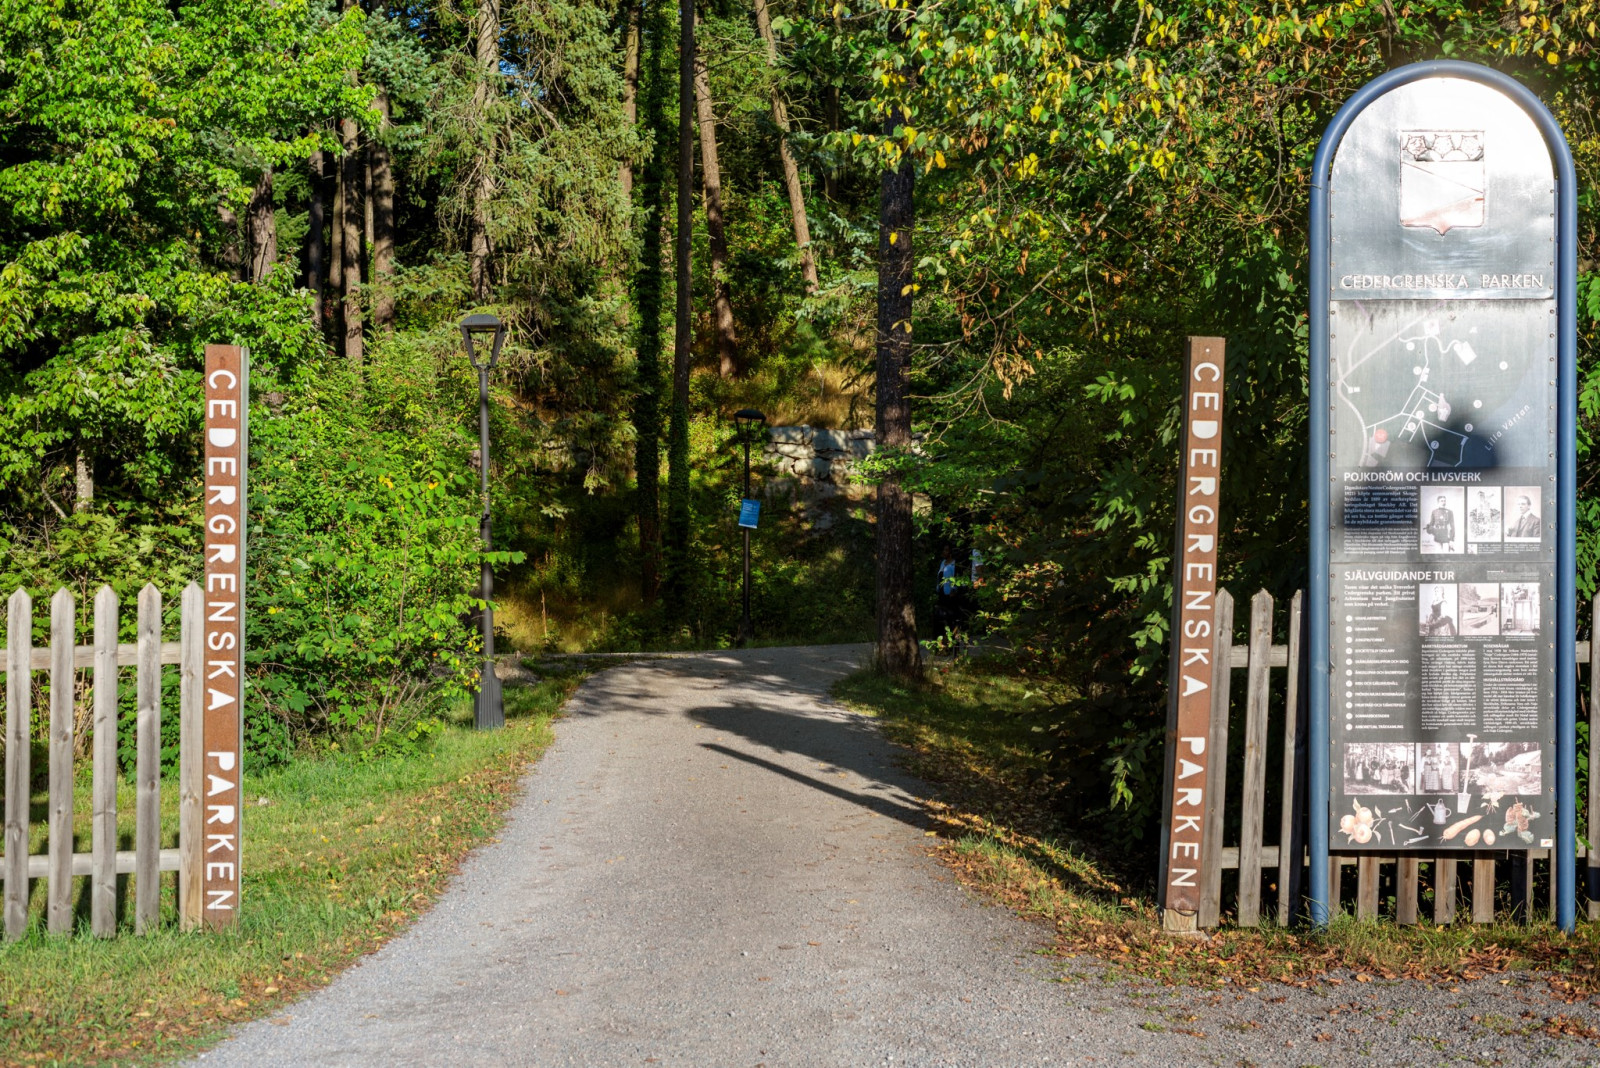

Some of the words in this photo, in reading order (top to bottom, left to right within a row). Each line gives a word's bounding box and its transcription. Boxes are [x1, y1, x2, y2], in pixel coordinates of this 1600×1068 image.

[1340, 274, 1469, 288] CEDERGRENSKA
[1482, 274, 1544, 288] PARKEN
[1344, 470, 1404, 482] POJKDRÖM
[1406, 472, 1429, 482] OCH
[1431, 472, 1482, 482] LIVSVERK
[1484, 430, 1502, 451] Lilla
[208, 369, 237, 711] CEDERGRENSKA
[1182, 362, 1221, 697] CEDERGRENSKA
[1344, 570, 1432, 581] SJÄLVGUIDANDE
[1433, 571, 1455, 581] TUR
[206, 751, 236, 910] PARKEN
[1170, 736, 1206, 887] PARKEN
